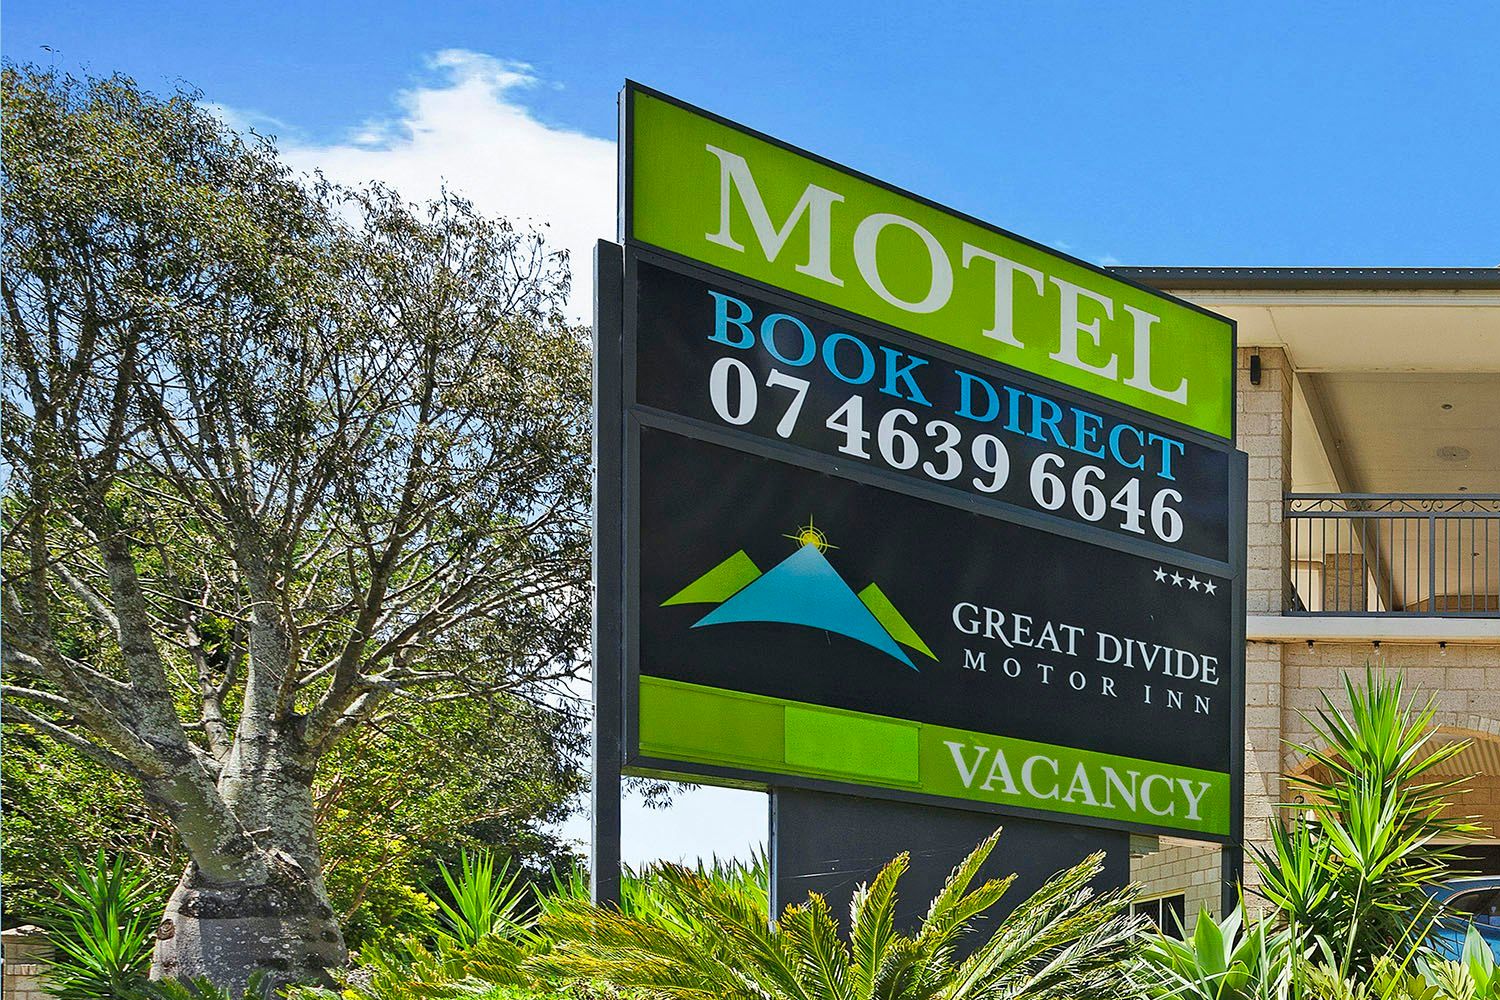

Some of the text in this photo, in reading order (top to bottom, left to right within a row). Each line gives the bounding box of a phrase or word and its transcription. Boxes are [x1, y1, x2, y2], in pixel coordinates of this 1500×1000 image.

[705, 143, 1188, 405] MOTEL
[707, 289, 1185, 481] BOOK DIRECT
[709, 357, 1184, 543] 07 4639 6646
[952, 602, 1220, 686] GREAT DIVIDE
[962, 648, 1211, 715] MOTOR INN
[943, 740, 1212, 821] VACANCY
